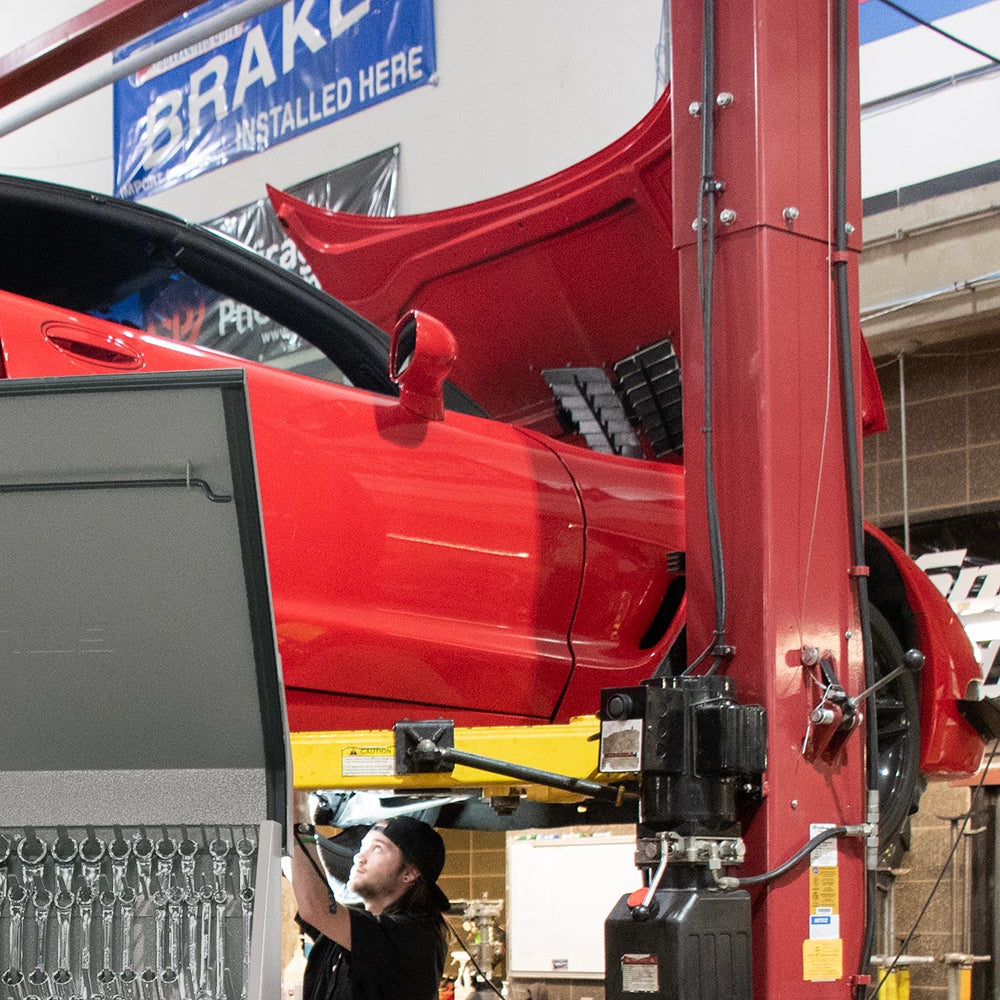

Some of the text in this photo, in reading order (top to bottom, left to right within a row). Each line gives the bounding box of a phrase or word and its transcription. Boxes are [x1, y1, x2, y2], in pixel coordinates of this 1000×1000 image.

[235, 45, 423, 150] INSTALLED HERE
[360, 747, 392, 755] CAUTION
